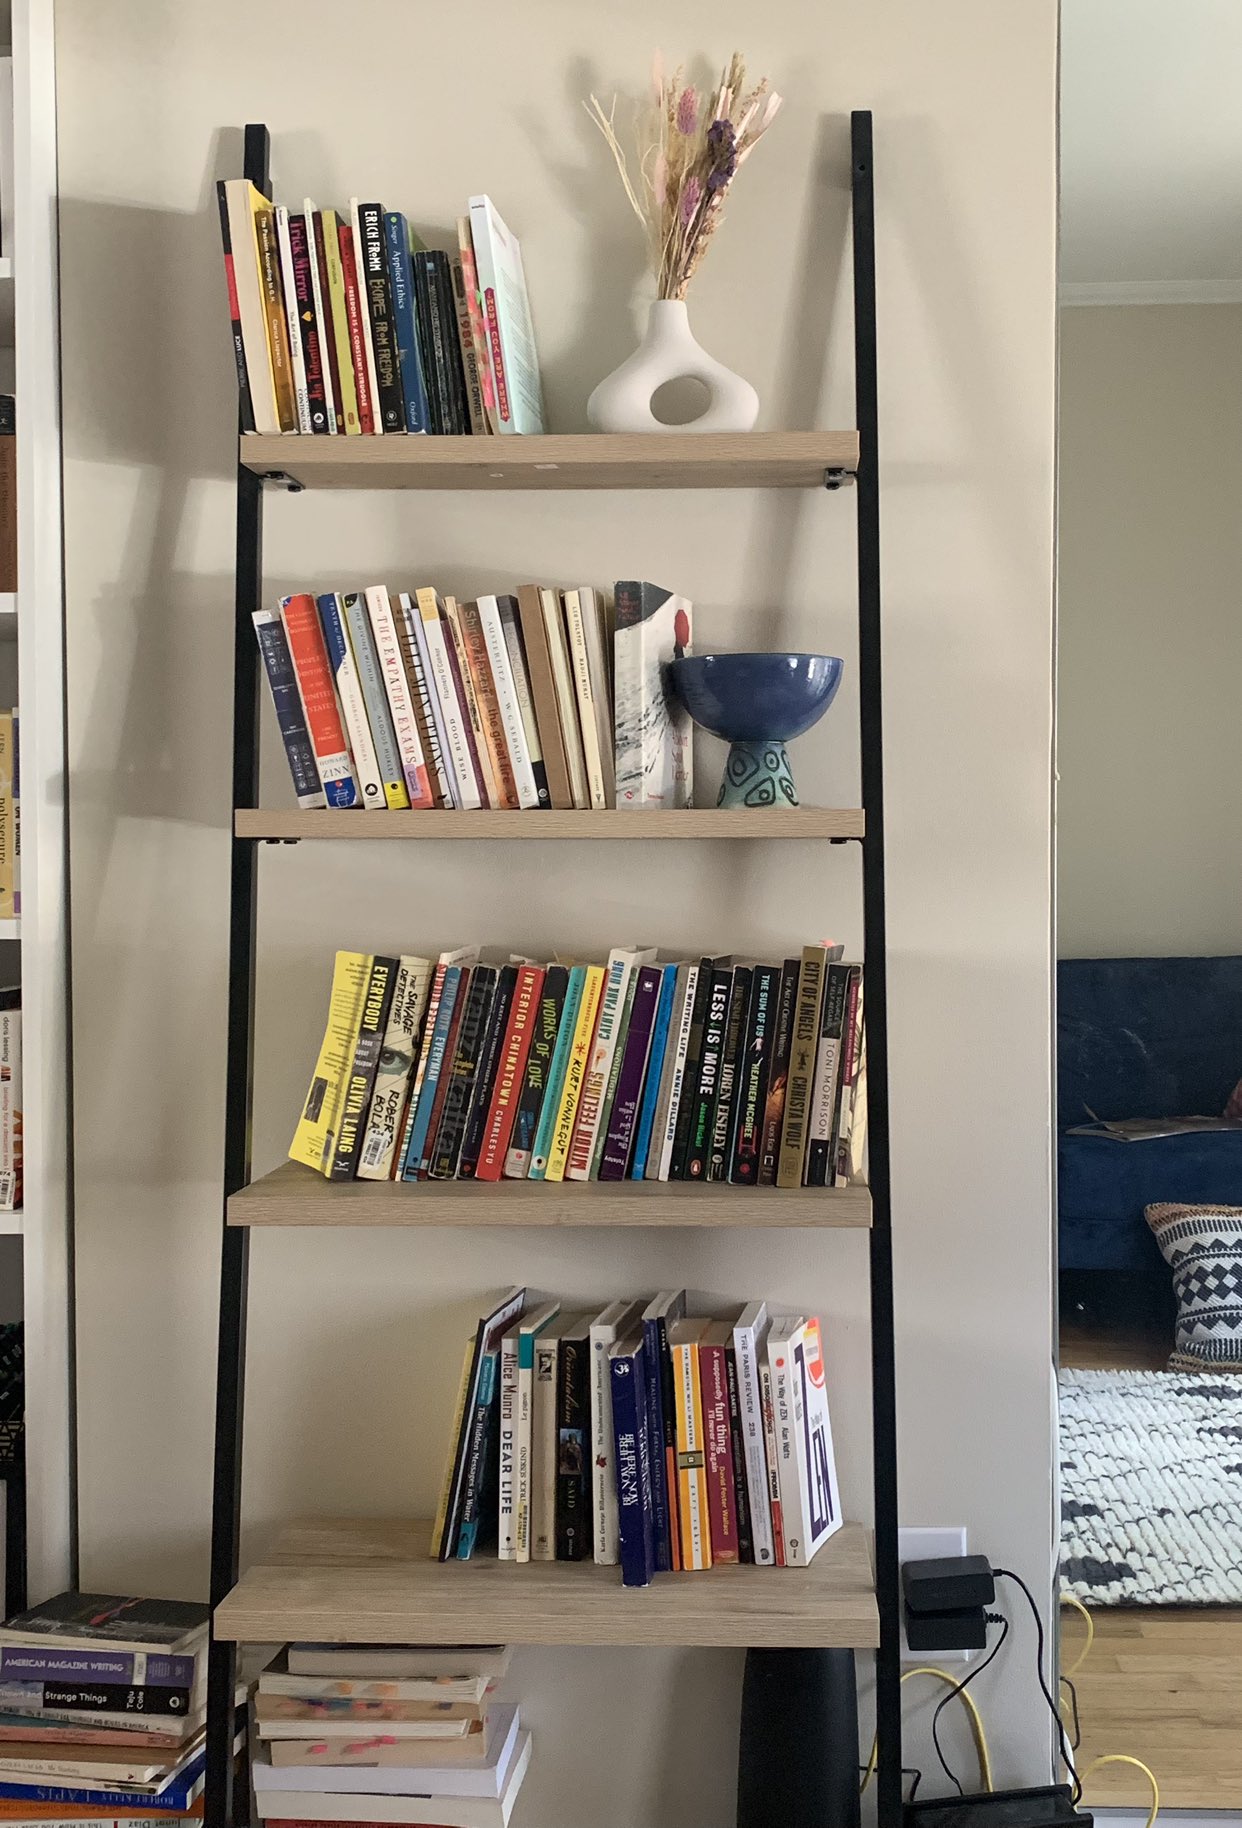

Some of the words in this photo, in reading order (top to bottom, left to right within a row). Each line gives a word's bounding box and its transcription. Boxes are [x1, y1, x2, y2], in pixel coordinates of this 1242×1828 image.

[290, 220, 306, 254] Trick
[364, 210, 378, 239] ERICH
[367, 242, 382, 272] FROMM
[391, 251, 404, 280] Applied
[294, 256, 308, 302] Mirror
[370, 278, 386, 318] ESCAPE
[396, 282, 405, 310] Ethics
[374, 321, 389, 348] FROM
[460, 311, 474, 348] 1984
[274, 340, 282, 368] Lispector
[306, 330, 322, 382] Tolentino
[354, 335, 363, 370] CONSTANT
[378, 348, 394, 388] FREEDOM
[466, 352, 478, 386] GEORGE
[310, 384, 324, 400] Jia
[358, 372, 368, 406] STRUGGLE
[470, 387, 483, 418] ORWELL
[298, 388, 307, 430] CONTINUUM
[410, 401, 418, 426] Oxford
[354, 608, 364, 622] THE
[357, 625, 369, 651] DIVINE
[364, 655, 374, 682] WITHIN
[464, 610, 480, 650] Shirley
[475, 651, 494, 700] Hazzard
[574, 620, 582, 646] TOLSTOY
[581, 679, 589, 700] MURAT
[376, 616, 392, 643] THE
[384, 648, 406, 712] EMPATHY
[397, 717, 416, 764] EXAMS
[308, 702, 334, 712] STATES
[401, 634, 445, 776] ILLUMINATIONS
[488, 708, 497, 726] the
[376, 714, 388, 745] ALDOUS
[384, 748, 394, 776] HUXLEY
[450, 718, 462, 752] BLOOD
[490, 728, 504, 762] great
[322, 766, 350, 778] ZINN
[458, 756, 468, 781] WISE
[500, 762, 510, 783] fire
[611, 960, 625, 983] HONG
[688, 972, 696, 990] THE
[760, 974, 770, 990] THE
[804, 961, 820, 985] CITY
[363, 965, 389, 1032] EVERYBODY
[393, 968, 408, 1026] DETECTIVES
[444, 978, 457, 1007] PHILIP
[514, 971, 536, 1030] INTERIOR
[568, 983, 580, 1008] JOAN
[606, 984, 618, 1009] PARK
[710, 984, 727, 1020] LESS
[758, 992, 768, 1011] SUM
[802, 987, 816, 1000] OF
[403, 990, 418, 1036] SAVAGE
[440, 1008, 452, 1031] ROTH
[542, 998, 556, 1040] WORKS
[598, 1010, 614, 1040] CATHY
[681, 994, 693, 1034] WRITING
[756, 1012, 766, 1023] OF
[797, 1002, 815, 1041] ANGELS
[560, 1009, 574, 1047] DIDION
[706, 1028, 721, 1044] IS
[755, 1024, 765, 1037] US
[427, 1036, 446, 1082] EVERYMAN
[536, 1042, 550, 1059] OF
[679, 1037, 687, 1058] LIFE
[825, 1044, 835, 1070] TONI
[500, 1034, 522, 1106] CHINATOWN
[528, 1059, 543, 1090] LOVE
[566, 1059, 583, 1092] KURT
[607, 1046, 622, 1100] MEDITATIONS
[672, 1068, 682, 1099] ANNIE
[700, 1052, 717, 1095] MORE
[720, 1064, 735, 1102] LOREN
[748, 1063, 760, 1102] HEATHER
[344, 1075, 368, 1118] OLIVIA
[788, 1076, 808, 1120] CHRISTA
[818, 1074, 832, 1136] MORRISON
[556, 1093, 577, 1155] VONNEGUT
[570, 1128, 590, 1170] MINOR
[581, 1071, 604, 1127] FEELINGS
[666, 1102, 678, 1141] DILLARD
[698, 1102, 707, 1123] Jason
[713, 1104, 729, 1150] EISELEY
[744, 1104, 756, 1138] MCGHEE
[338, 1118, 359, 1154] LAING
[489, 1110, 504, 1148] CHARLES
[695, 1124, 704, 1148] Hickel
[785, 1122, 802, 1150] WOLF
[486, 1151, 494, 1165] YU
[712, 1350, 720, 1358] A
[741, 1335, 749, 1351] THE
[504, 1352, 517, 1379] Alice
[712, 1359, 723, 1400] supposedly
[742, 1354, 751, 1380] PARIS
[777, 1374, 785, 1385] The
[564, 1345, 578, 1424] Orientalism
[745, 1382, 755, 1414] REVIEW
[778, 1387, 786, 1401] Way
[477, 1407, 485, 1421] The
[504, 1384, 517, 1420] Munro
[716, 1402, 727, 1421] fun
[780, 1408, 788, 1420] ZEN
[473, 1422, 483, 1451] Hidden
[716, 1424, 728, 1454] thing
[782, 1427, 790, 1440] Alan
[502, 1430, 513, 1474] DEAR
[733, 1430, 743, 1473] existentialism
[782, 1442, 791, 1459] Watts
[468, 1452, 479, 1488] Messages
[467, 1488, 473, 1497] in
[501, 1483, 512, 1515] LIFE
[567, 1480, 576, 1508] SAID
[720, 1487, 728, 1508] Foster
[771, 1471, 779, 1499] FROMM
[463, 1498, 474, 1522] Water
[722, 1509, 730, 1536] Wallace
[5, 1658, 46, 1667] AMERICAN
[48, 1660, 88, 1670] MAGAZINE
[90, 1662, 124, 1672] WRITING
[45, 1692, 77, 1702] Strange
[79, 1693, 108, 1704] Things
[127, 1691, 135, 1709] Teju
[37, 1788, 91, 1802] LAPIS
[102, 1794, 132, 1803] KELLY
[137, 1796, 174, 1805] ROBERT
